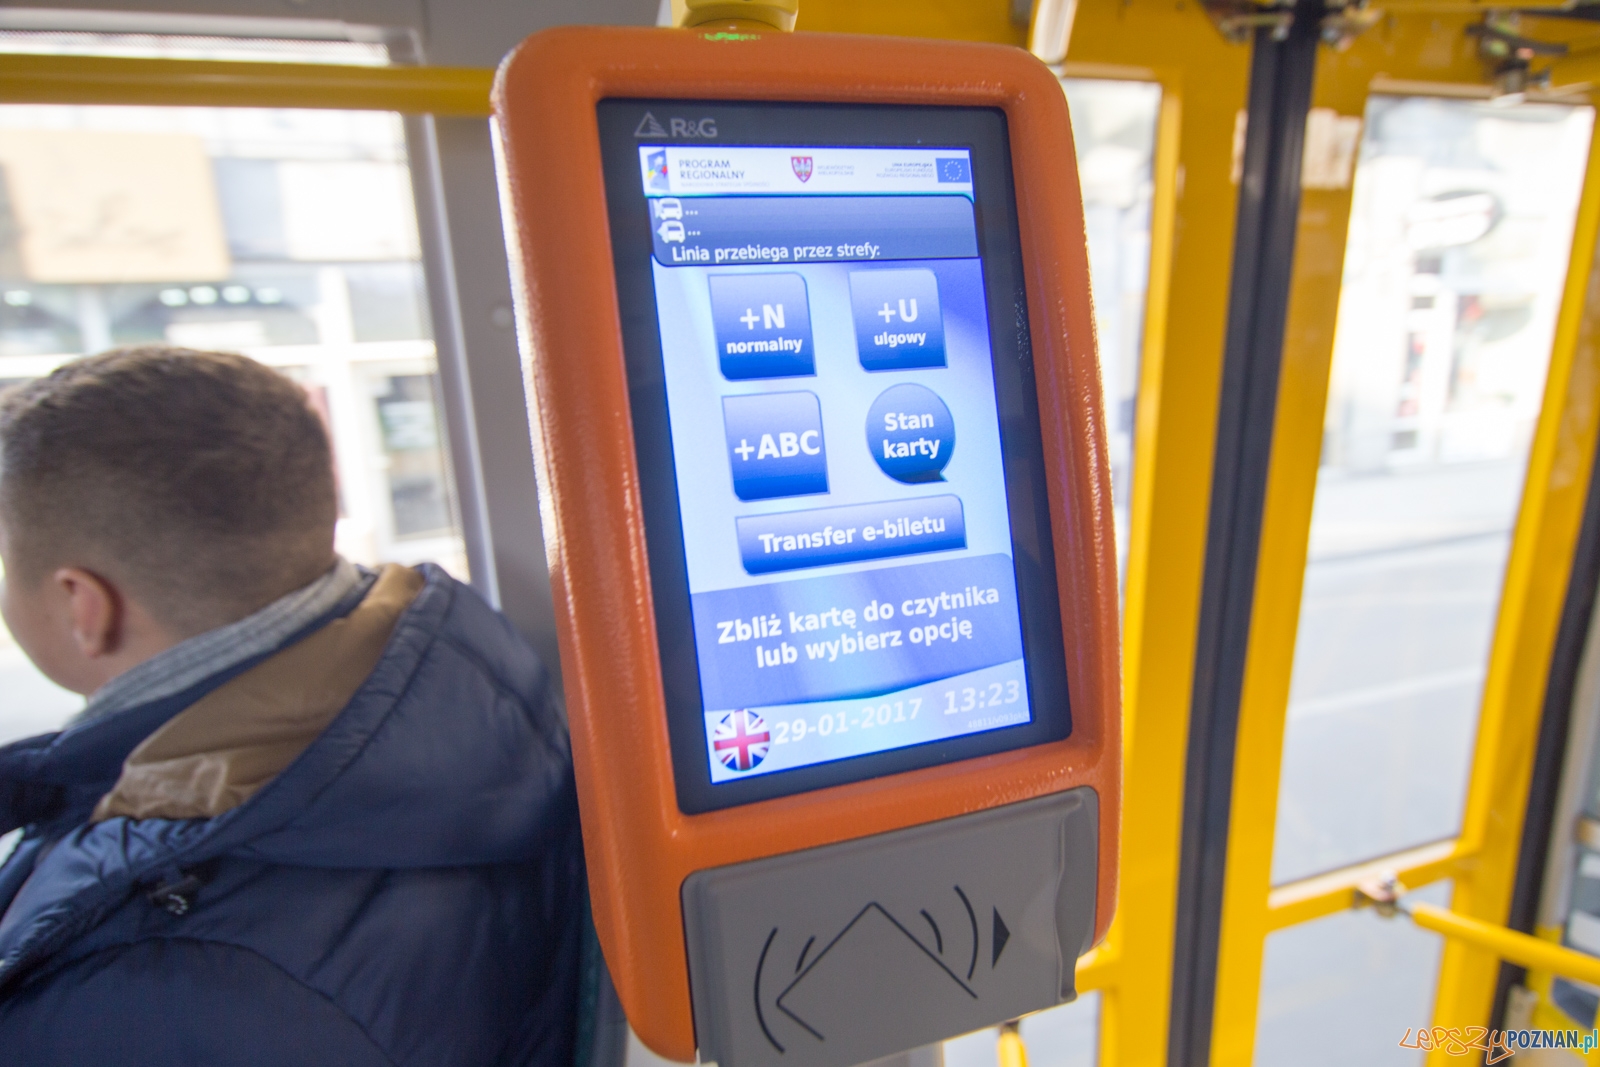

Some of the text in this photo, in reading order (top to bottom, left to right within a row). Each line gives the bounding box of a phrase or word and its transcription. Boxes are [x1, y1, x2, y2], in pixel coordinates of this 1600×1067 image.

[670, 118, 718, 138] R&G
[679, 159, 731, 169] PROGRAM
[680, 170, 745, 180] REGIONALNY
[672, 242, 881, 263] Linia przebiega przez strefy:
[739, 304, 786, 330] +N
[877, 298, 919, 323] +U
[726, 337, 803, 354] normalny
[873, 331, 927, 348] ulgowy
[884, 412, 935, 431] Stan
[734, 430, 821, 461] +ABC
[882, 438, 941, 460] karty
[758, 516, 946, 554] Transfer e-biletu
[716, 585, 1001, 645] Zbliż kartę do czytnika
[755, 617, 973, 668] lub wybierz opcję
[773, 679, 1020, 746] 29-01-2017 13:23
